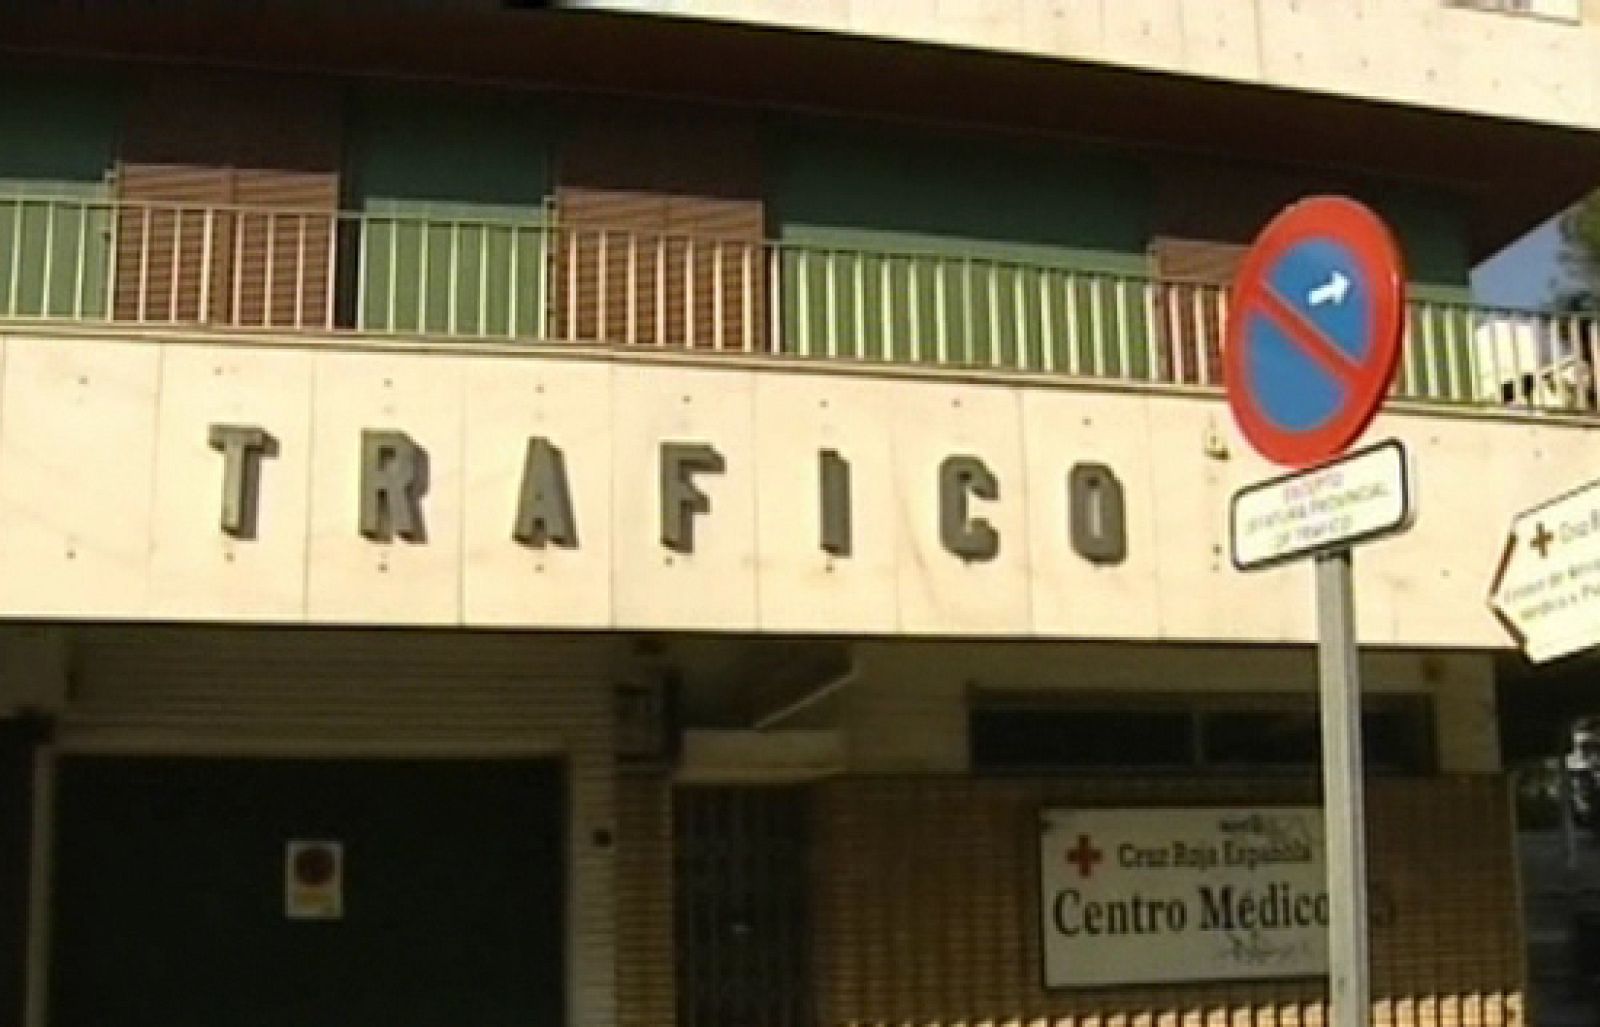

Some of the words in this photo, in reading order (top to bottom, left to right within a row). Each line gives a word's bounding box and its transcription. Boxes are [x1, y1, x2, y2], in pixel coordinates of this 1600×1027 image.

[207, 424, 1128, 566] TRAFICO
[1116, 842, 1170, 868] Cruz
[1171, 840, 1217, 871] Roja
[1052, 887, 1188, 938] Centro
